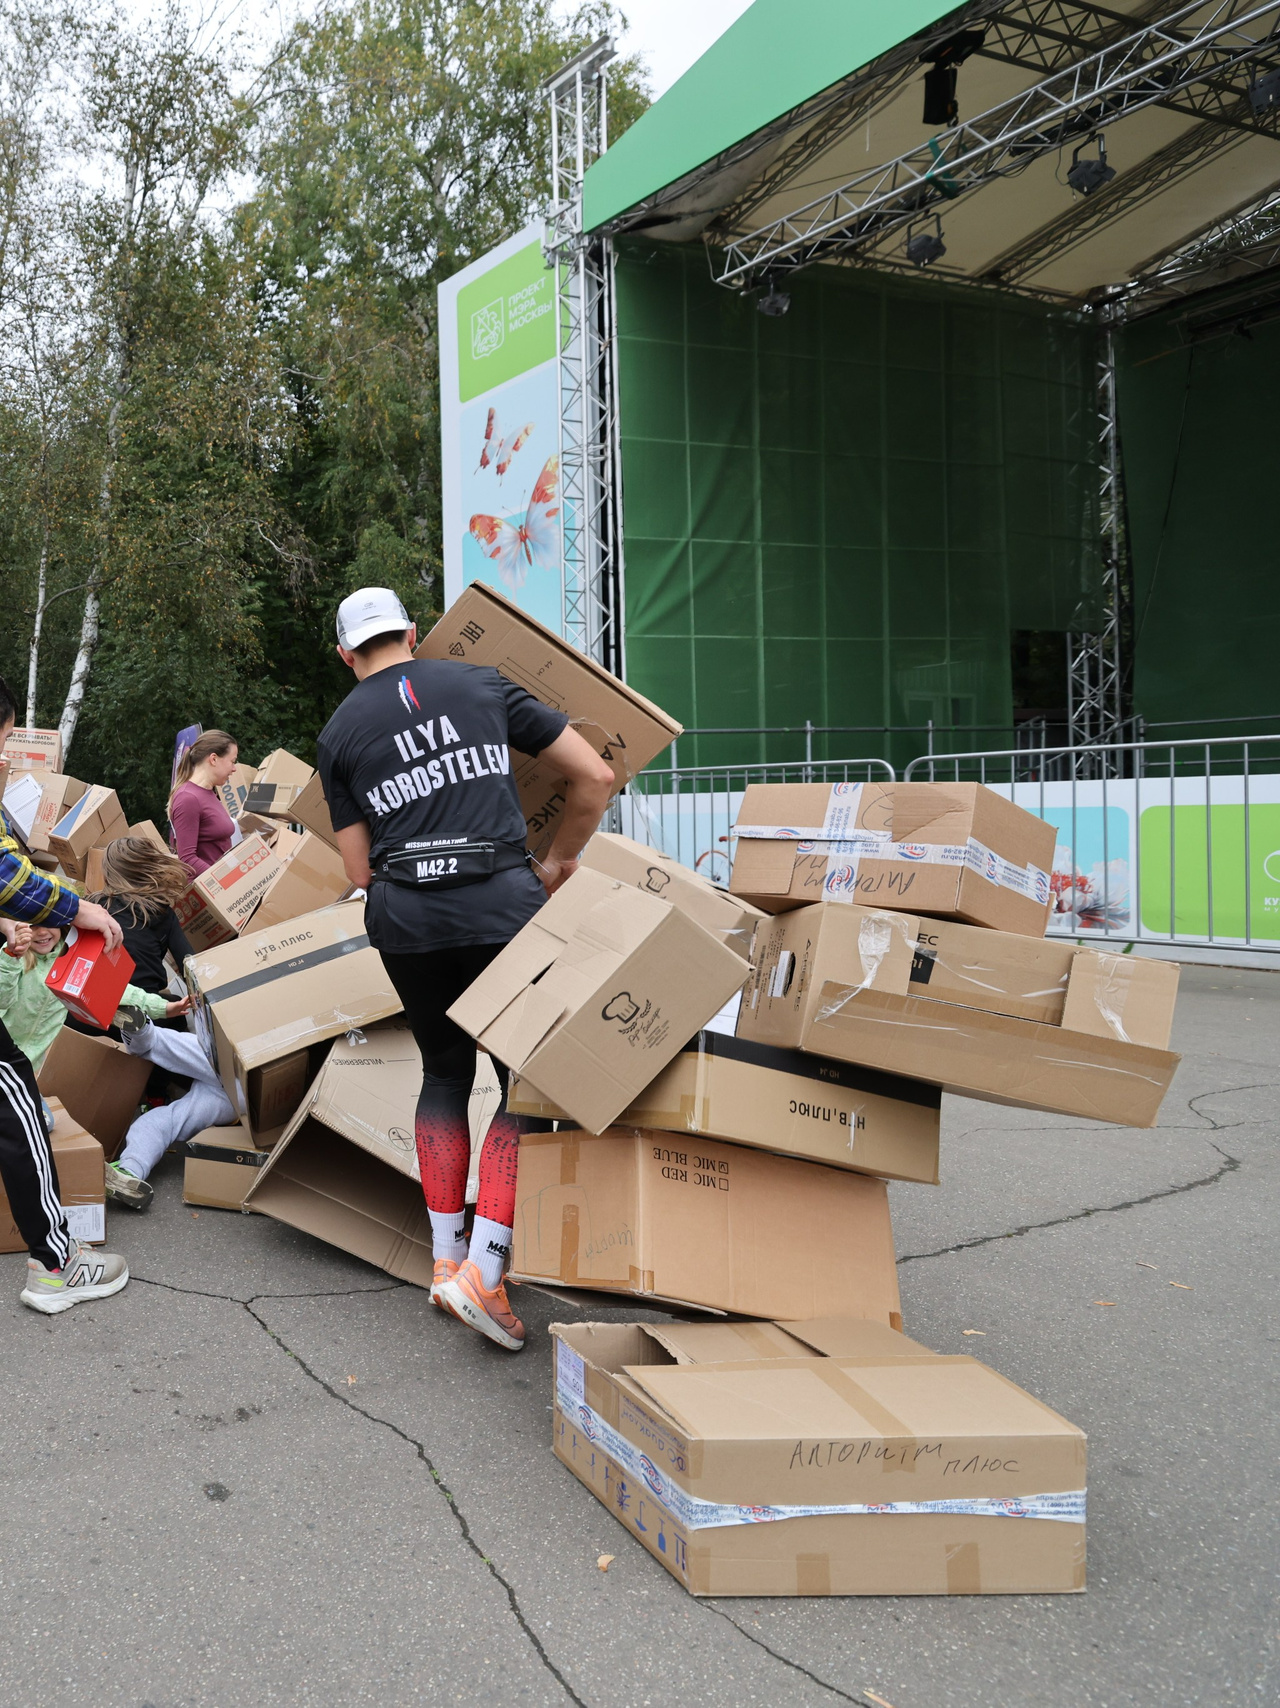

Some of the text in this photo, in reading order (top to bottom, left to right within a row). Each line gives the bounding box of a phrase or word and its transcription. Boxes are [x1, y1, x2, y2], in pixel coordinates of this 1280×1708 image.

[508, 276, 546, 308] ПРОЕКТ
[508, 297, 536, 320] МЭРА
[508, 299, 552, 333] МОСКВЫ
[394, 715, 461, 763] ILYA
[366, 744, 510, 816] KOROSTELEV
[405, 837, 468, 849] MISSION MARATHON
[416, 857, 458, 878] M42.2
[254, 931, 314, 957] НТВ ПЛЮС
[331, 1058, 385, 1066] WILDBERRIES
[788, 1100, 831, 1121] ПЛЮС
[652, 1147, 716, 1170] MIC BLUE
[661, 1166, 716, 1187] MIC RED
